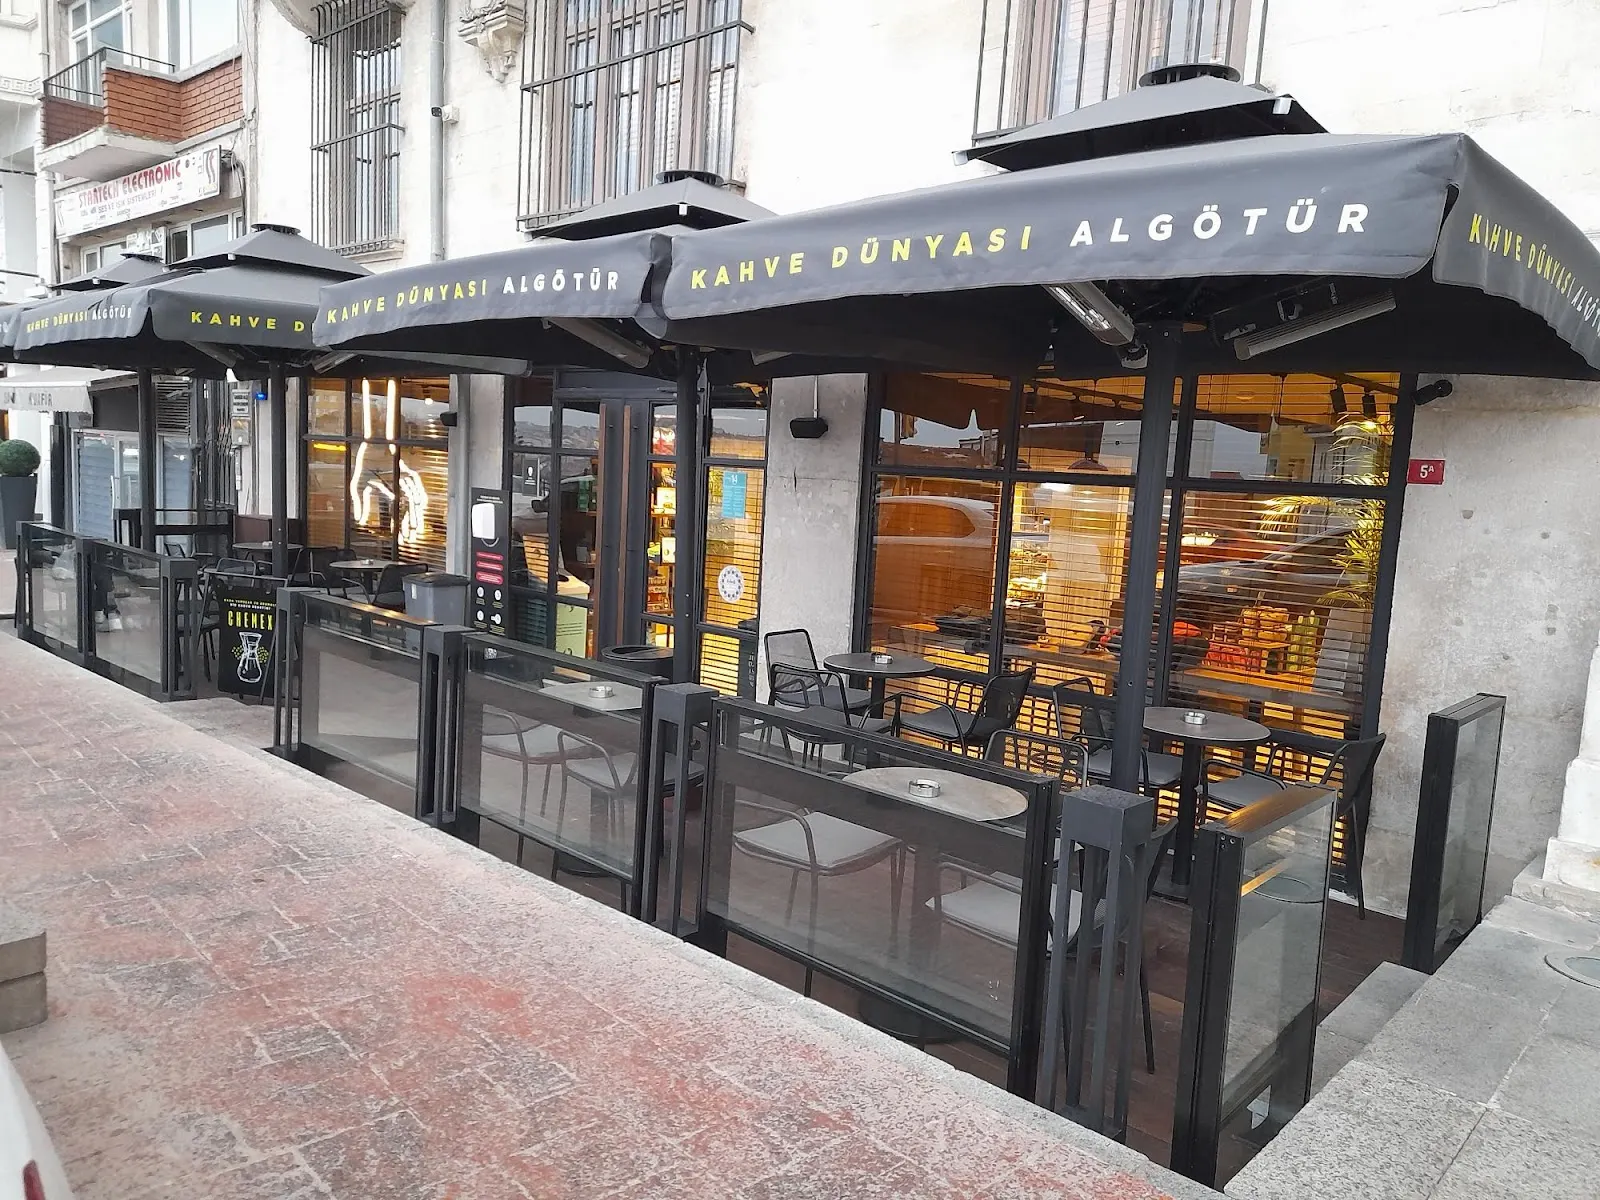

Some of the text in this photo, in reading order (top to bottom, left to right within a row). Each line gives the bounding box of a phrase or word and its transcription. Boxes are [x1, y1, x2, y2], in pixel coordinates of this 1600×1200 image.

[78, 180, 120, 209] STARTECH
[691, 198, 1370, 290] KAHVE DÜNYASI ALGÖTÜR
[327, 268, 619, 324] KAHVE DÜNYASI ALGÖTÜR
[26, 317, 50, 333] KAHVE
[53, 310, 88, 327] DÜNYASI
[92, 304, 132, 321] ALGÖTÜR
[190, 311, 277, 330] KAHVE
[1420, 465, 1435, 479] 5A
[228, 611, 273, 630] CHEMEX
